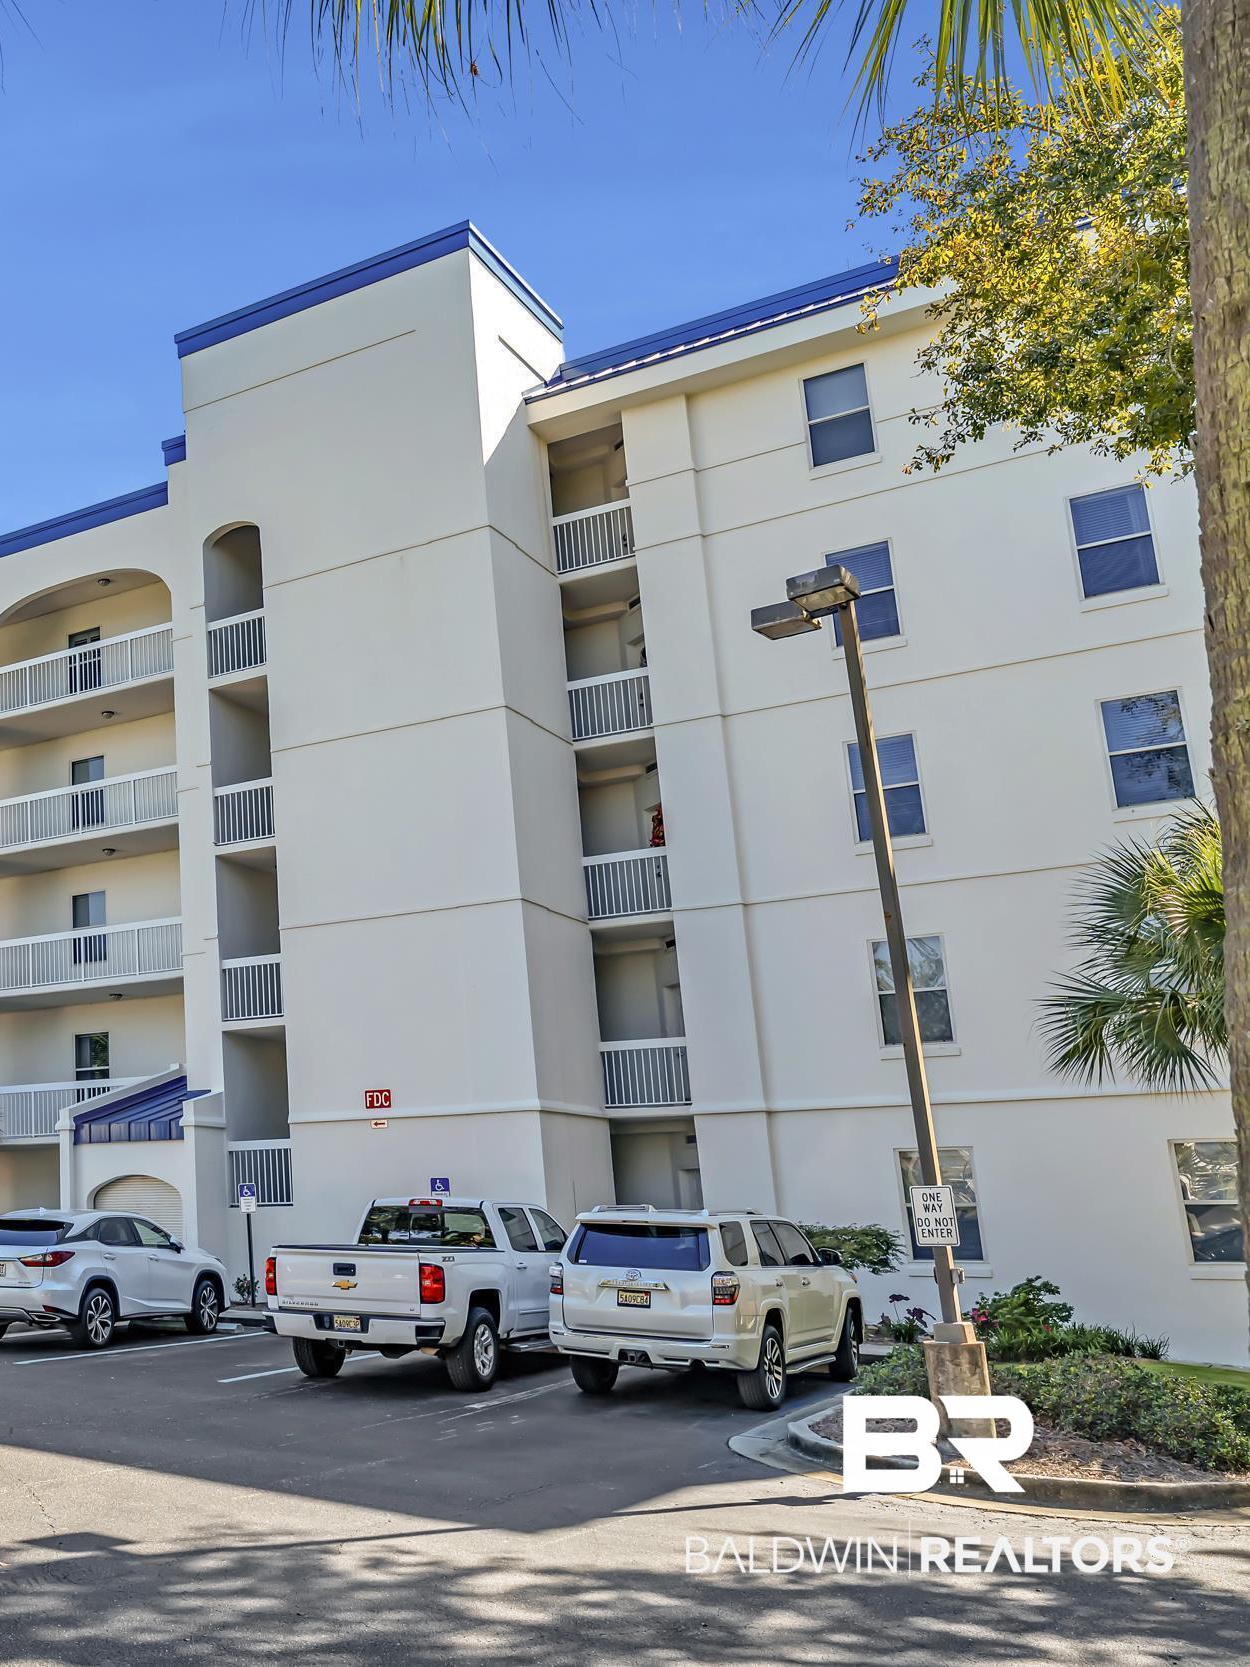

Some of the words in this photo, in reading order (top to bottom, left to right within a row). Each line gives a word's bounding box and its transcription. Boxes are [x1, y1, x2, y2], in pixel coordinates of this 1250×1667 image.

[366, 1091, 390, 1107] FDC
[921, 1192, 943, 1203] ONE
[922, 1203, 943, 1213] WAY
[917, 1217, 931, 1228] DO
[935, 1217, 954, 1228] NOT
[921, 1228, 953, 1238] ENTER
